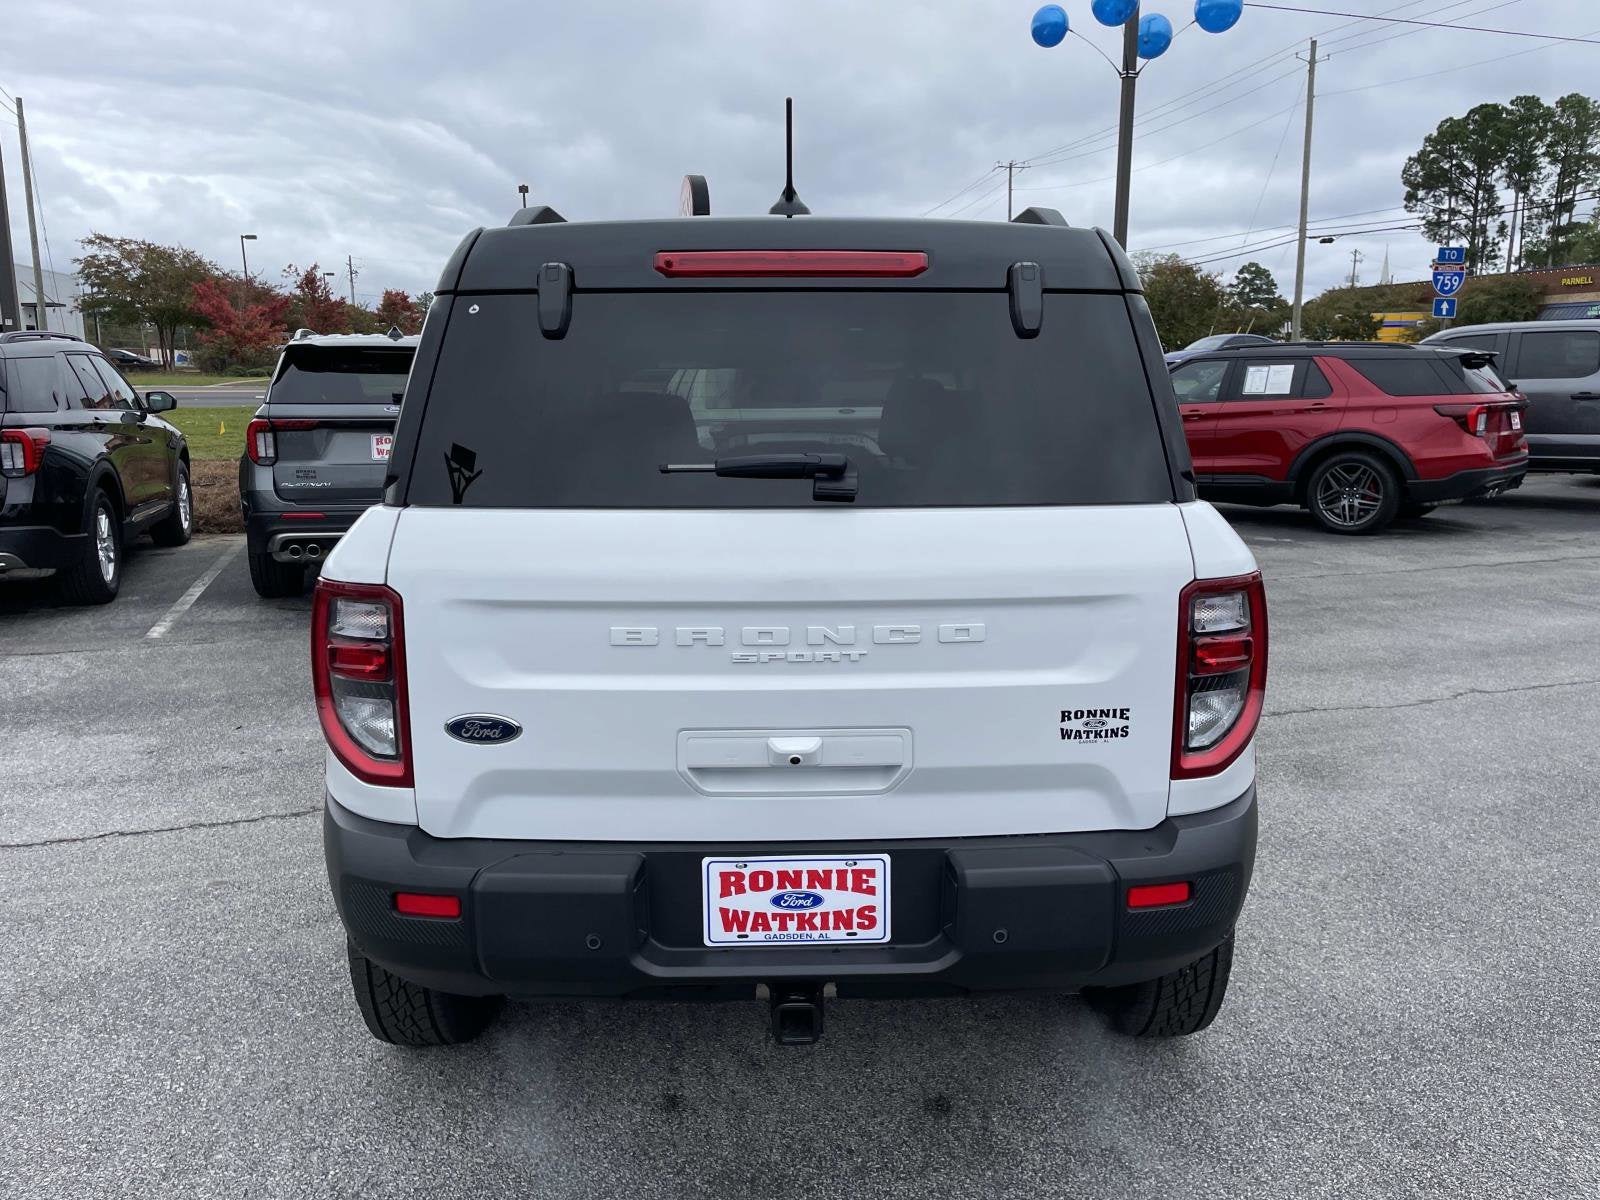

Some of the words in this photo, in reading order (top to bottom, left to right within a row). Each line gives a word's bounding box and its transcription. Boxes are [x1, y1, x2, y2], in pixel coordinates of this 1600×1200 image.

[1444, 250, 1457, 260] TO
[1436, 275, 1459, 290] 759
[1561, 276, 1593, 286] PARNELL
[609, 623, 987, 646] BRONCO
[731, 650, 868, 664] SPORT
[1060, 708, 1130, 723] RONNIE
[461, 720, 503, 738] Ford
[1060, 725, 1130, 740] WATKINS
[719, 868, 877, 899] RONNIE
[780, 893, 813, 907] Ford
[719, 904, 878, 932] WATKINS
[764, 932, 815, 941] GADSDEN,
